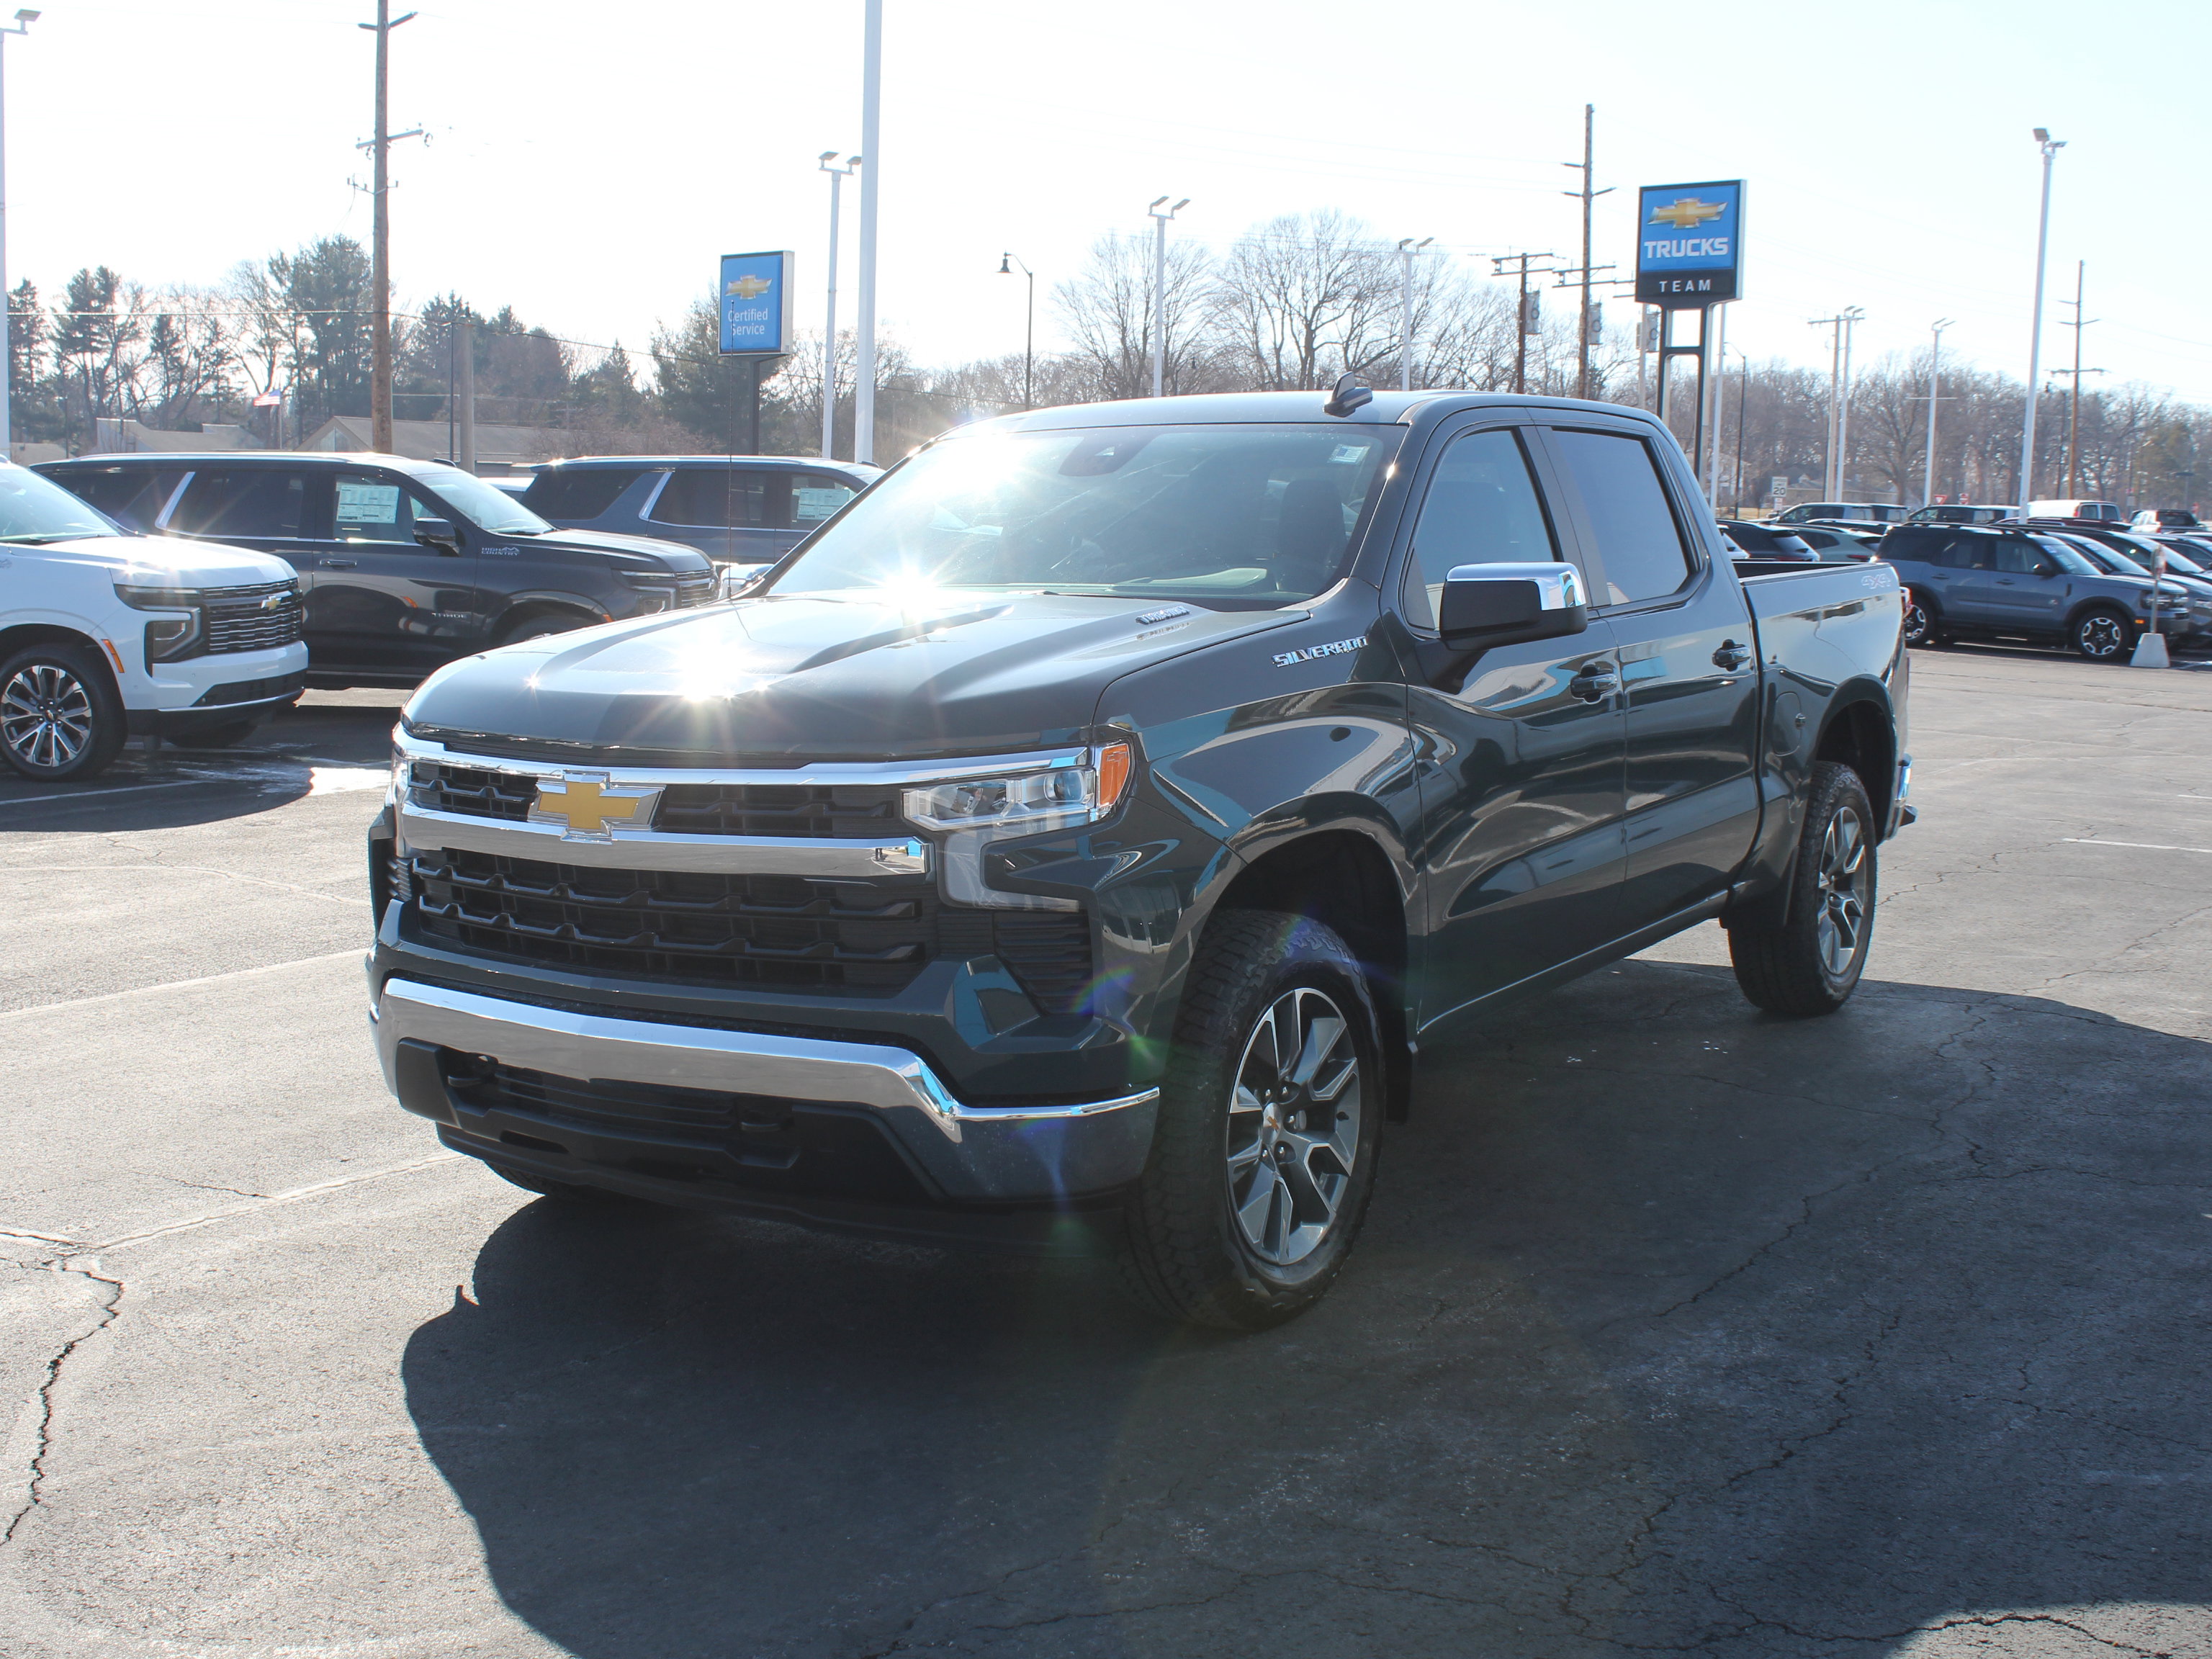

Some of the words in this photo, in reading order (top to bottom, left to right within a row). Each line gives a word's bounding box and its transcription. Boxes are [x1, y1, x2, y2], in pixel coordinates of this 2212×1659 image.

[1644, 237, 1729, 258] TRUCKS
[1659, 279, 1712, 292] TEAM
[727, 307, 768, 323] Certified
[730, 323, 765, 336] Service
[1773, 487, 1786, 495] 20
[1272, 635, 1368, 668] SILVERADO
